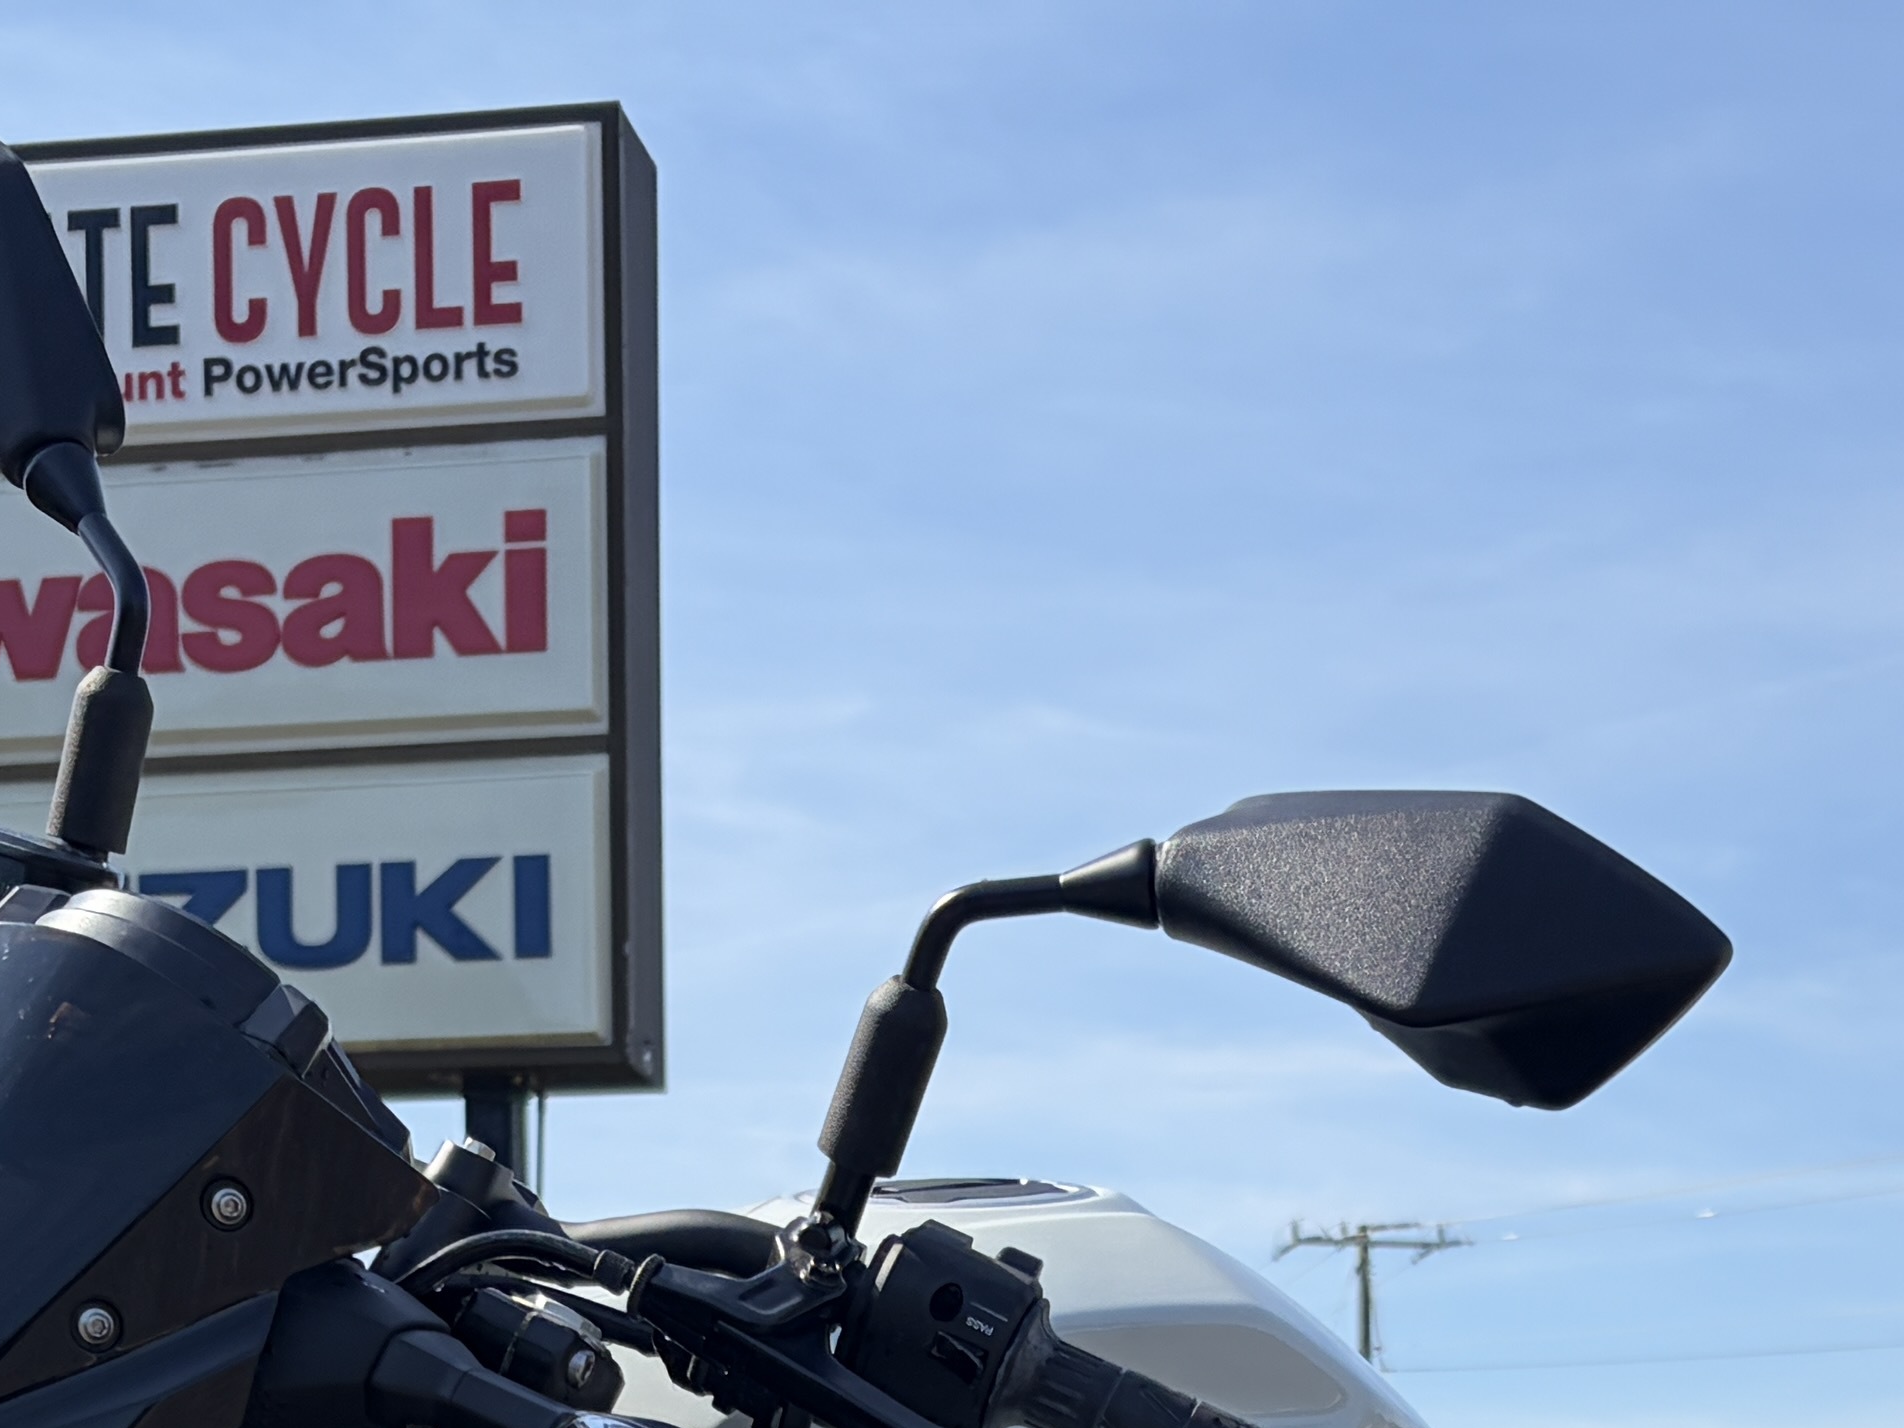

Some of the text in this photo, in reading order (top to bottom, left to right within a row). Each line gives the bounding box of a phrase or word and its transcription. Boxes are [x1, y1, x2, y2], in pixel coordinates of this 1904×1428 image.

[212, 178, 523, 343] CYCLE
[203, 342, 520, 396] PowerSports
[137, 853, 553, 970] ZUKI
[965, 1316, 994, 1337] PASS
